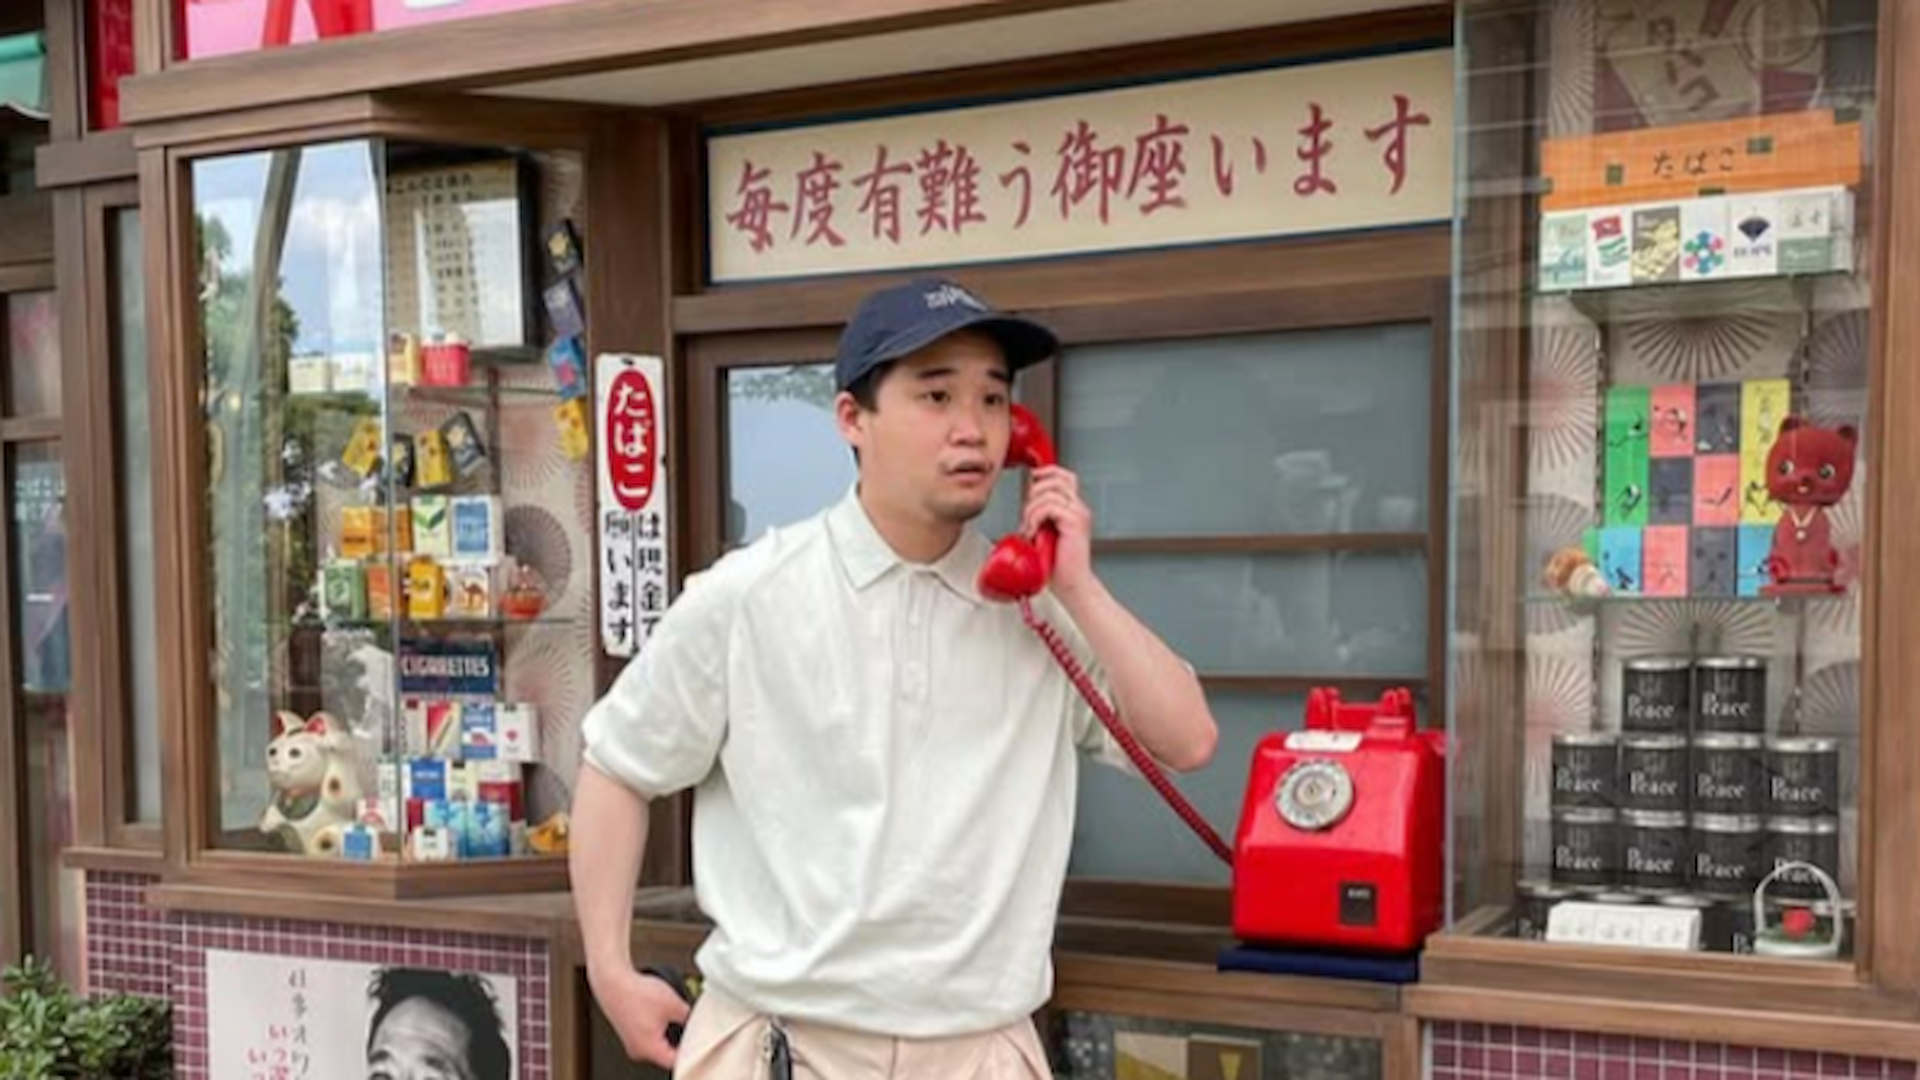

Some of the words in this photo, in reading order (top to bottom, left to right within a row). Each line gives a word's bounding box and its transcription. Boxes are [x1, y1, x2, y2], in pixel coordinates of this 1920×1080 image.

[726, 94, 1431, 254] 毎度有難う御座います
[614, 381, 650, 497] たばこ
[401, 655, 491, 678] CIGARETTES
[1628, 694, 1674, 720] Peace
[1702, 692, 1751, 717] Peace
[1556, 768, 1602, 794] Peace
[1630, 771, 1677, 796] Peace
[1697, 773, 1745, 799] Peace
[1771, 777, 1822, 803] Peace
[1556, 845, 1602, 870] Peace
[1628, 848, 1674, 873] Peace
[1697, 853, 1745, 878] Peace
